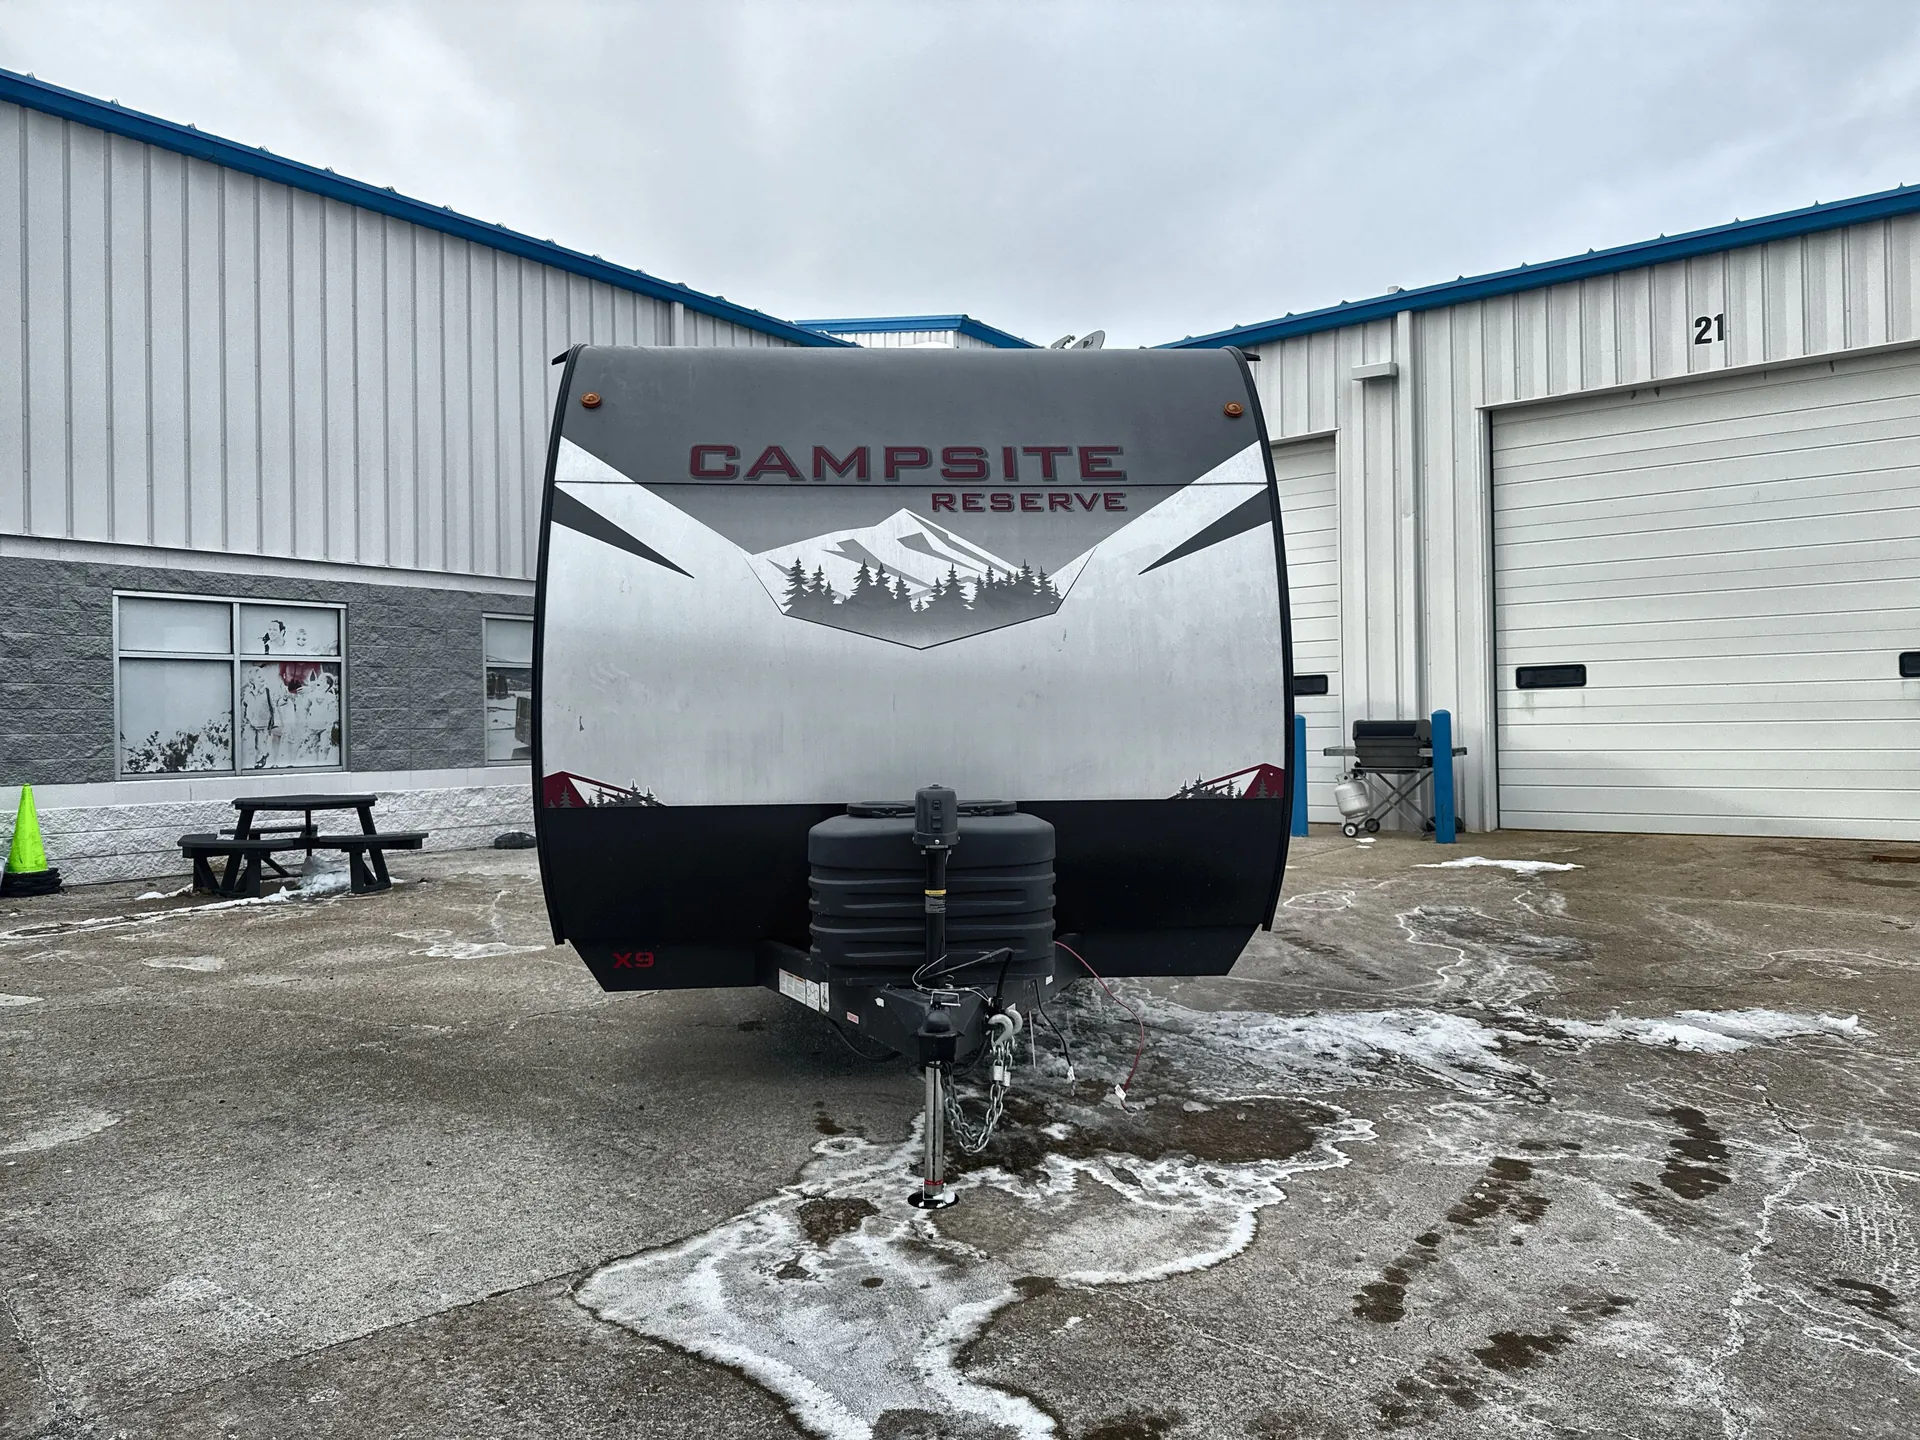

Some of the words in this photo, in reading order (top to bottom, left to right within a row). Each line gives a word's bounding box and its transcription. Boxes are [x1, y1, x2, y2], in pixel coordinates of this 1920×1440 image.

[1694, 313, 1724, 345] 21
[689, 444, 1127, 481] CAMPSITE
[931, 492, 1127, 512] RESERVE
[612, 951, 655, 969] X9
